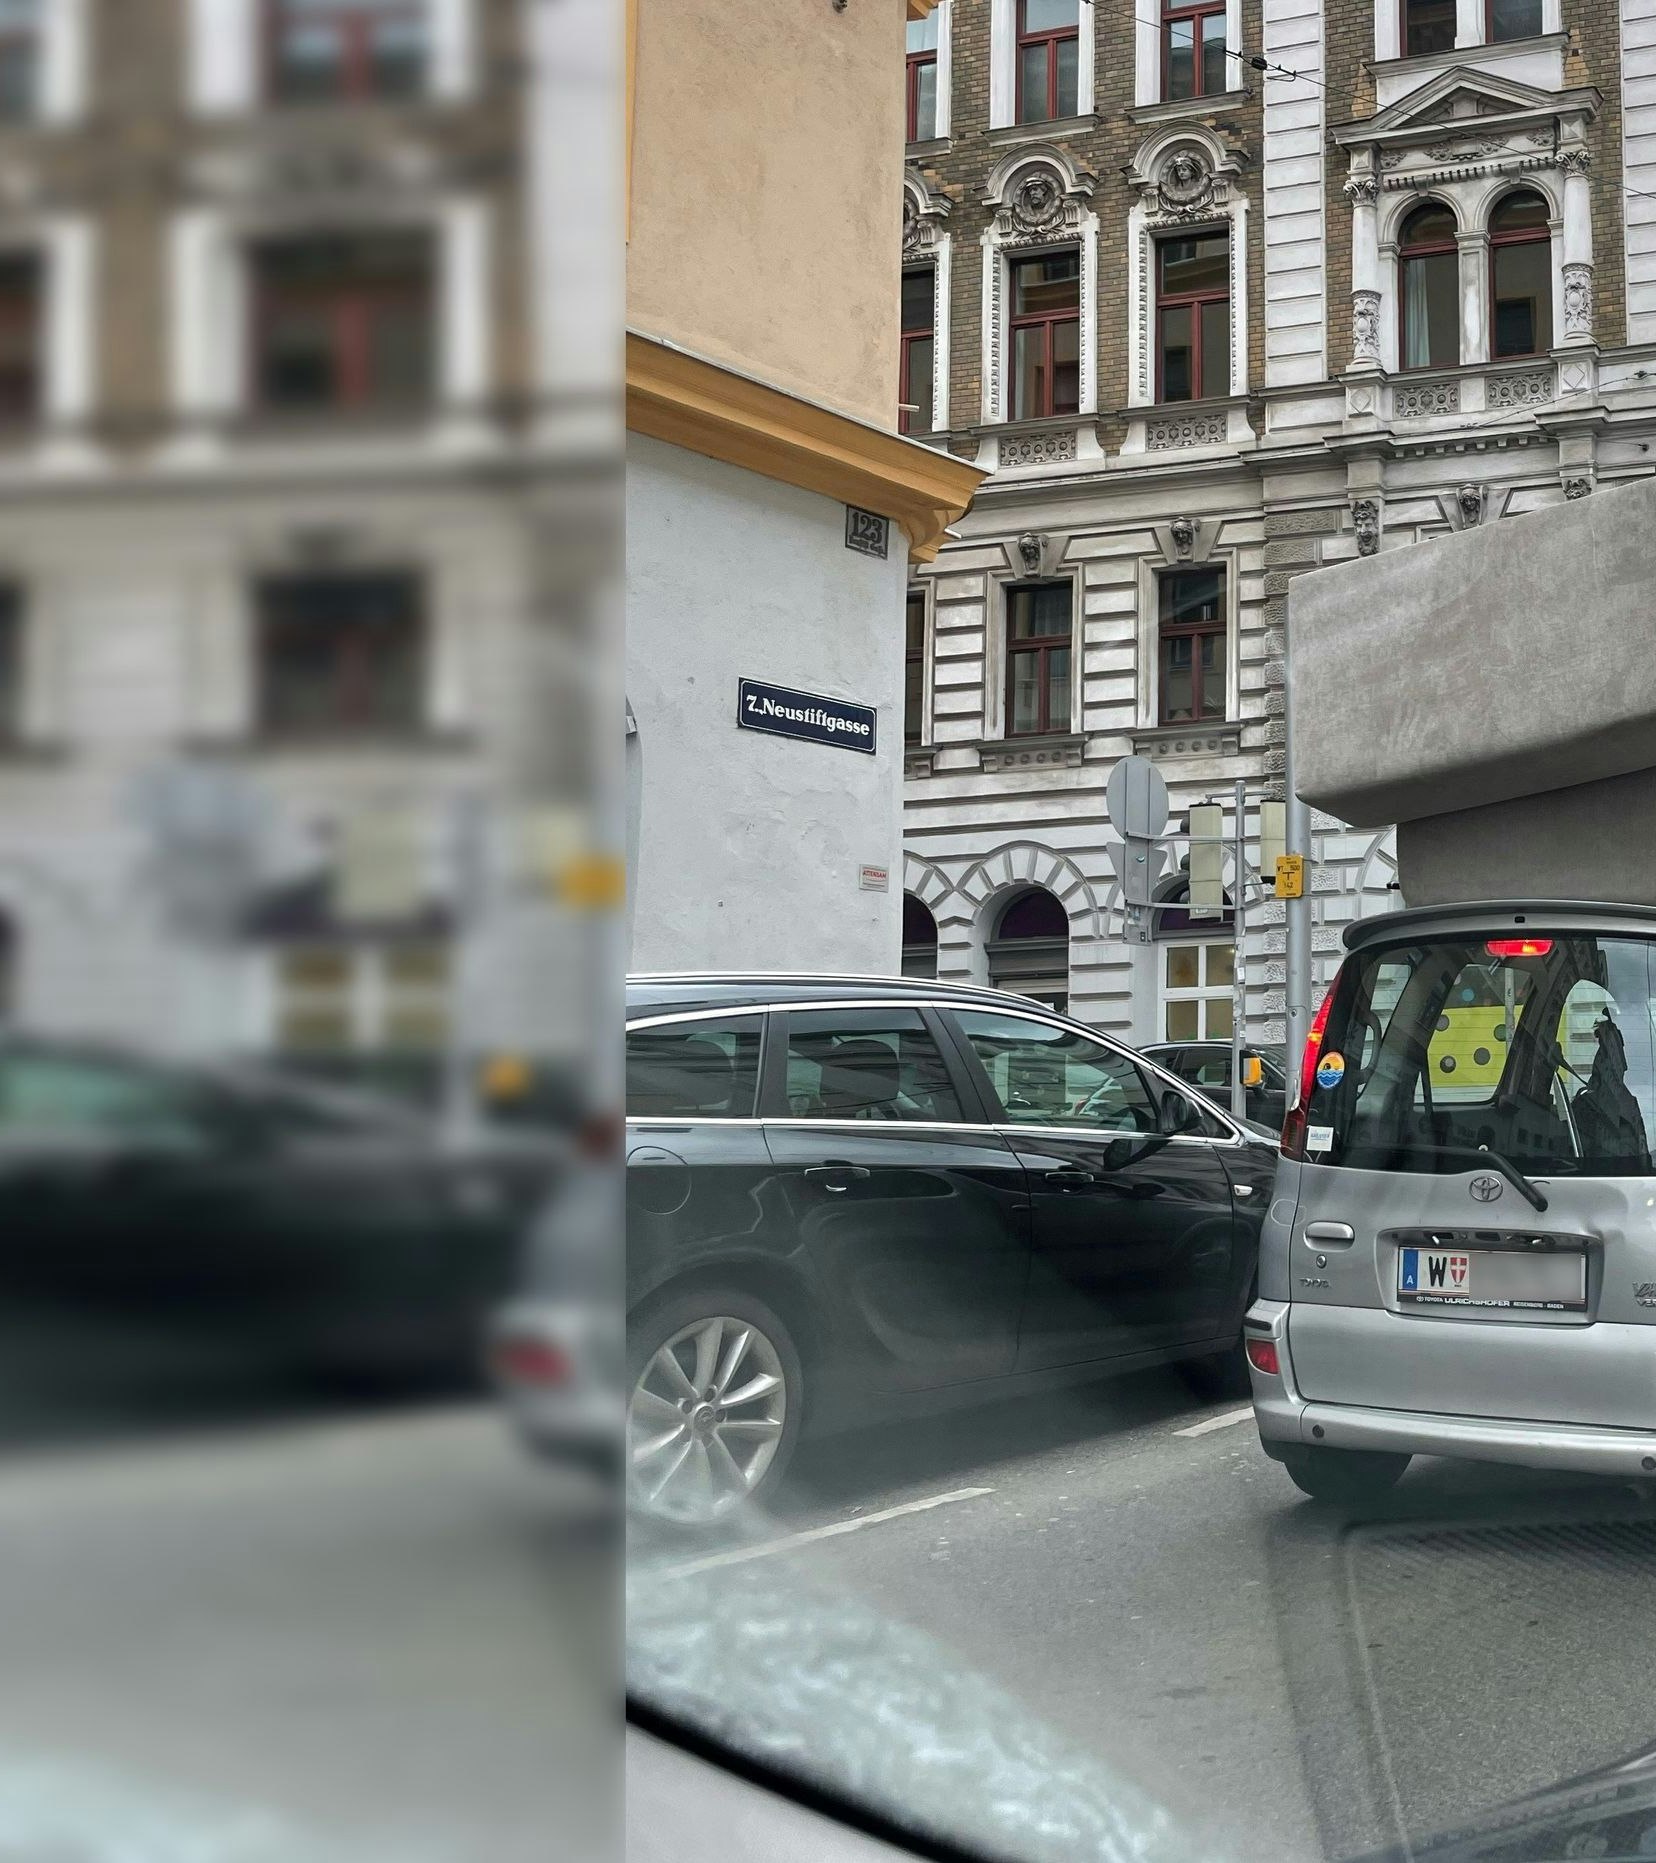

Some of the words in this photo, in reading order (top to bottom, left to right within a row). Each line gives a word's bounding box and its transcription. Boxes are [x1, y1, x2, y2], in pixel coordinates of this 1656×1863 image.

[851, 512, 883, 544] 123
[763, 698, 870, 735] Neustiftgasse
[1406, 1274, 1414, 1285] A
[1428, 1255, 1447, 1287] W
